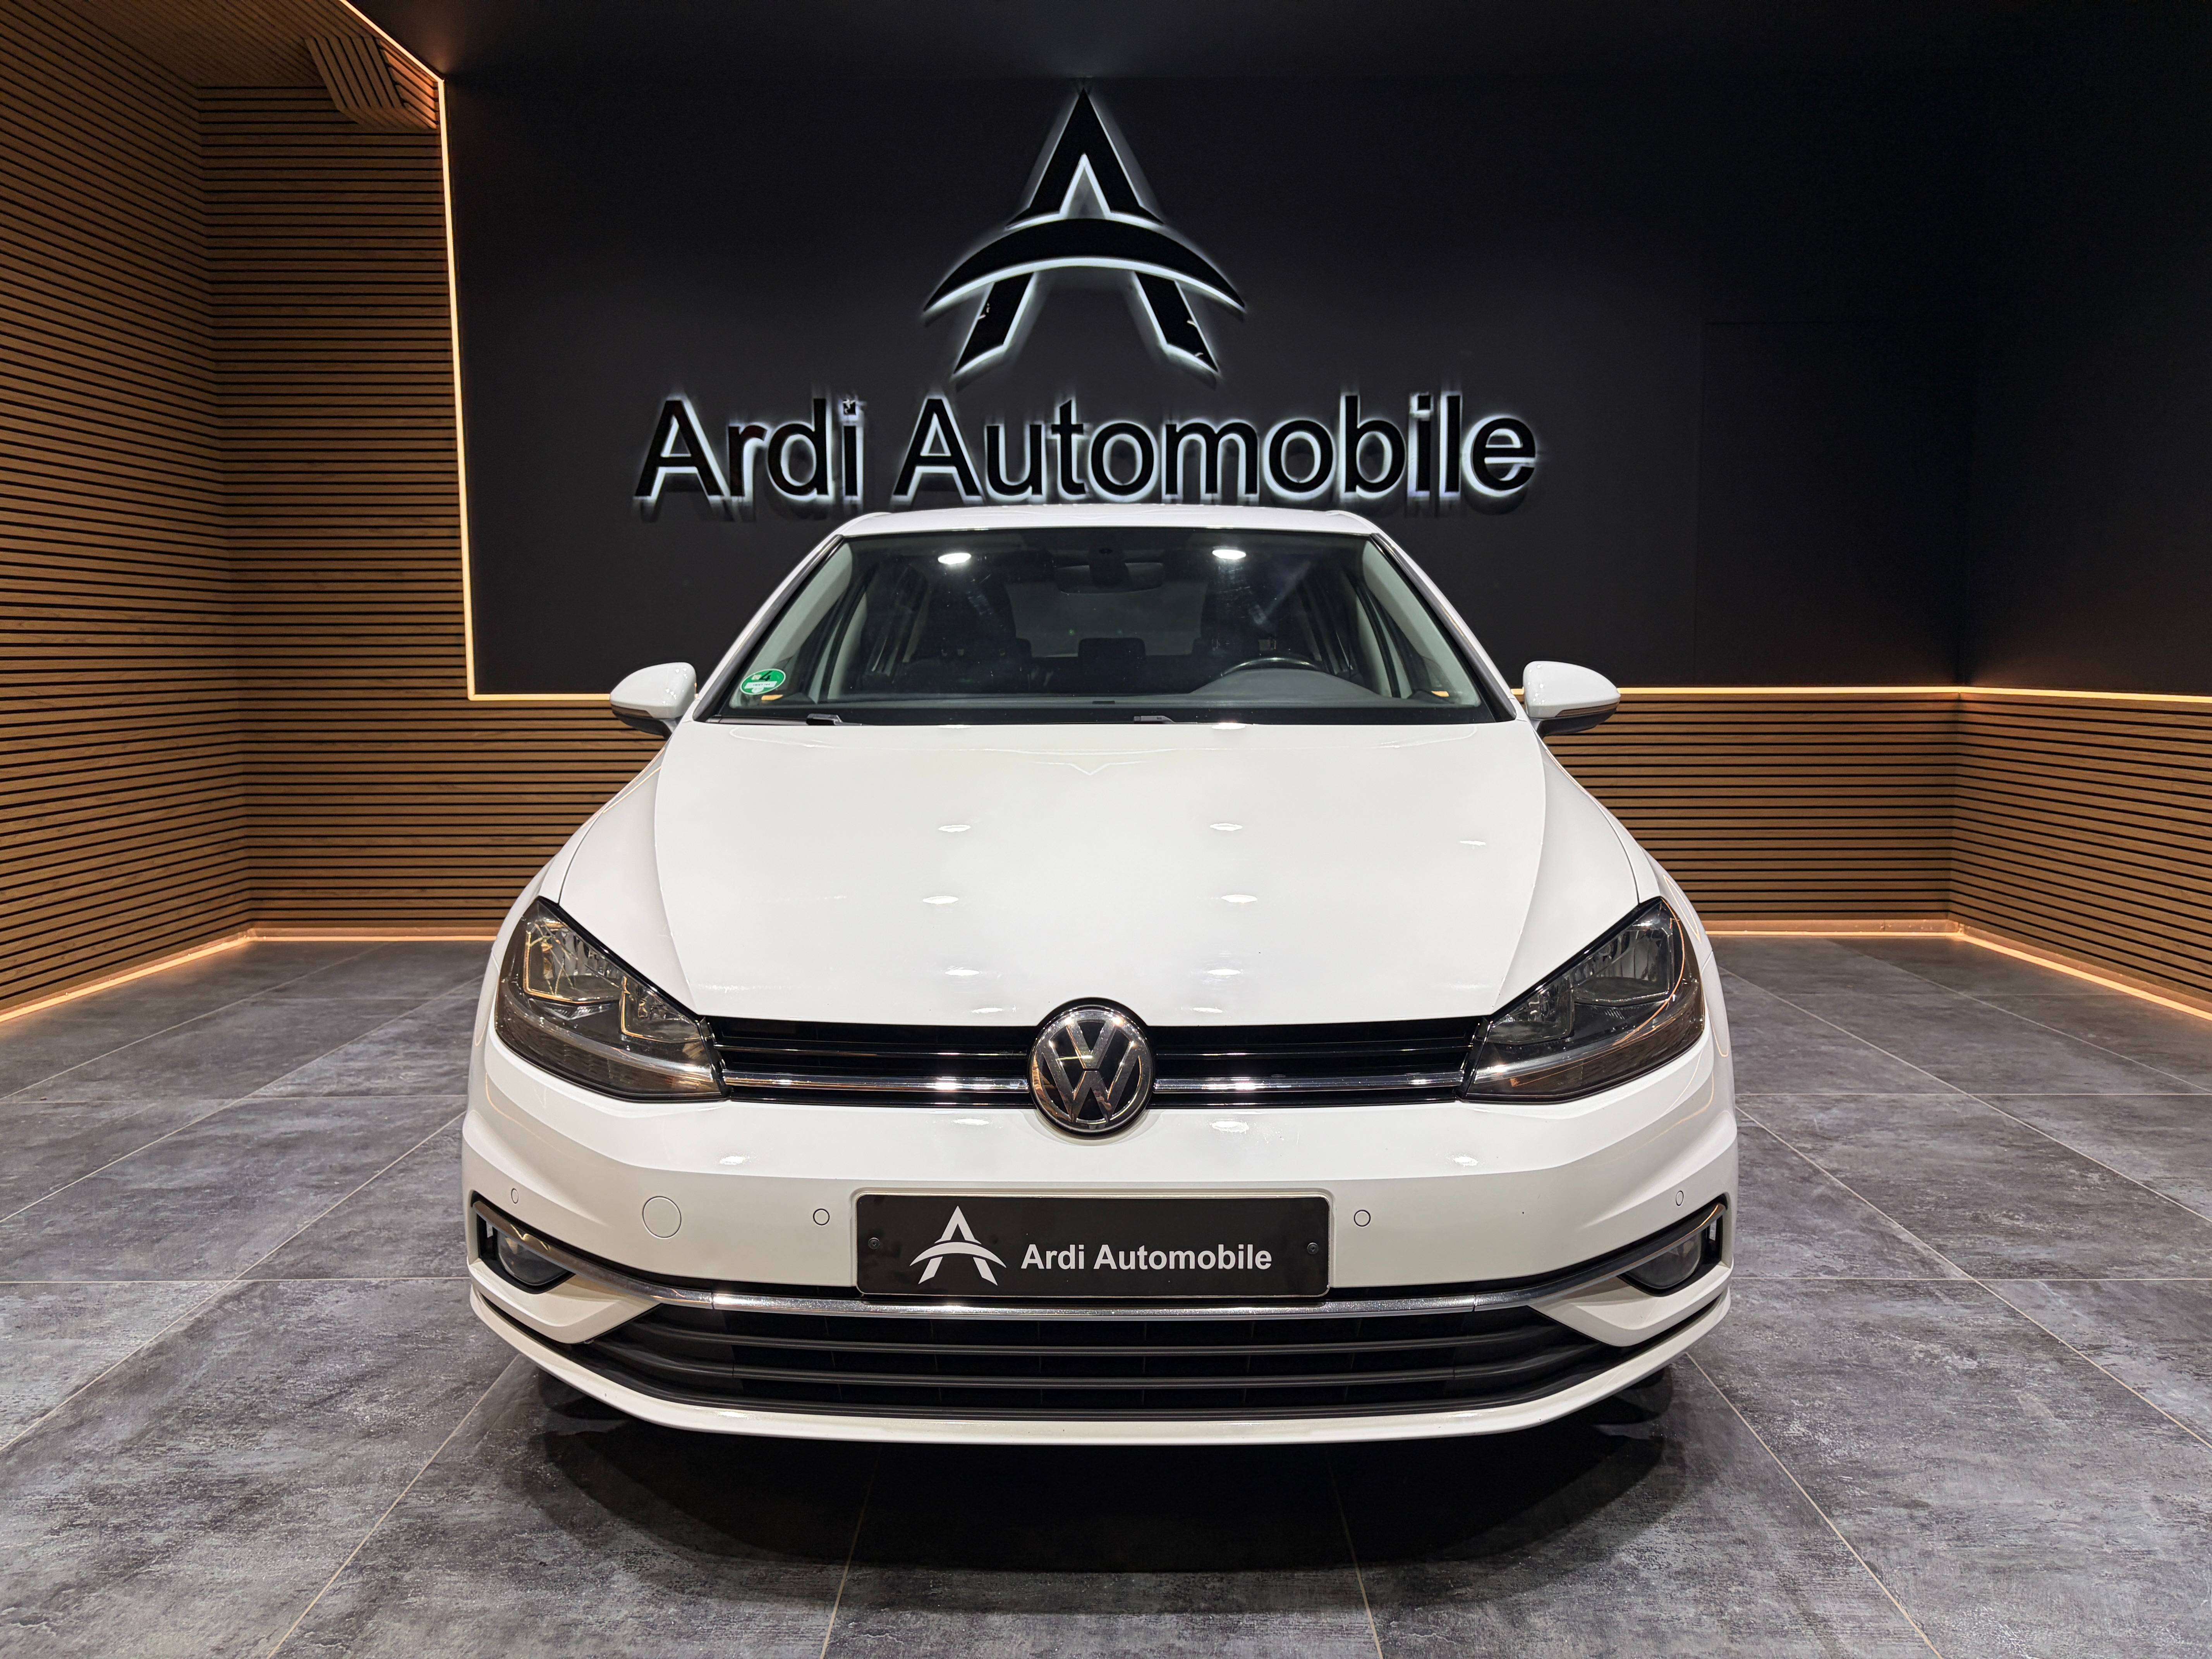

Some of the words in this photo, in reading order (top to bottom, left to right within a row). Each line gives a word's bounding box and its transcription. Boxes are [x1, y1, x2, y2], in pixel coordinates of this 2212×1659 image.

[635, 398, 859, 496] Ardi
[893, 395, 1536, 496] Automobile
[758, 670, 773, 682] 4
[1021, 1244, 1084, 1269] Ardi
[1093, 1244, 1272, 1270] Automobile
